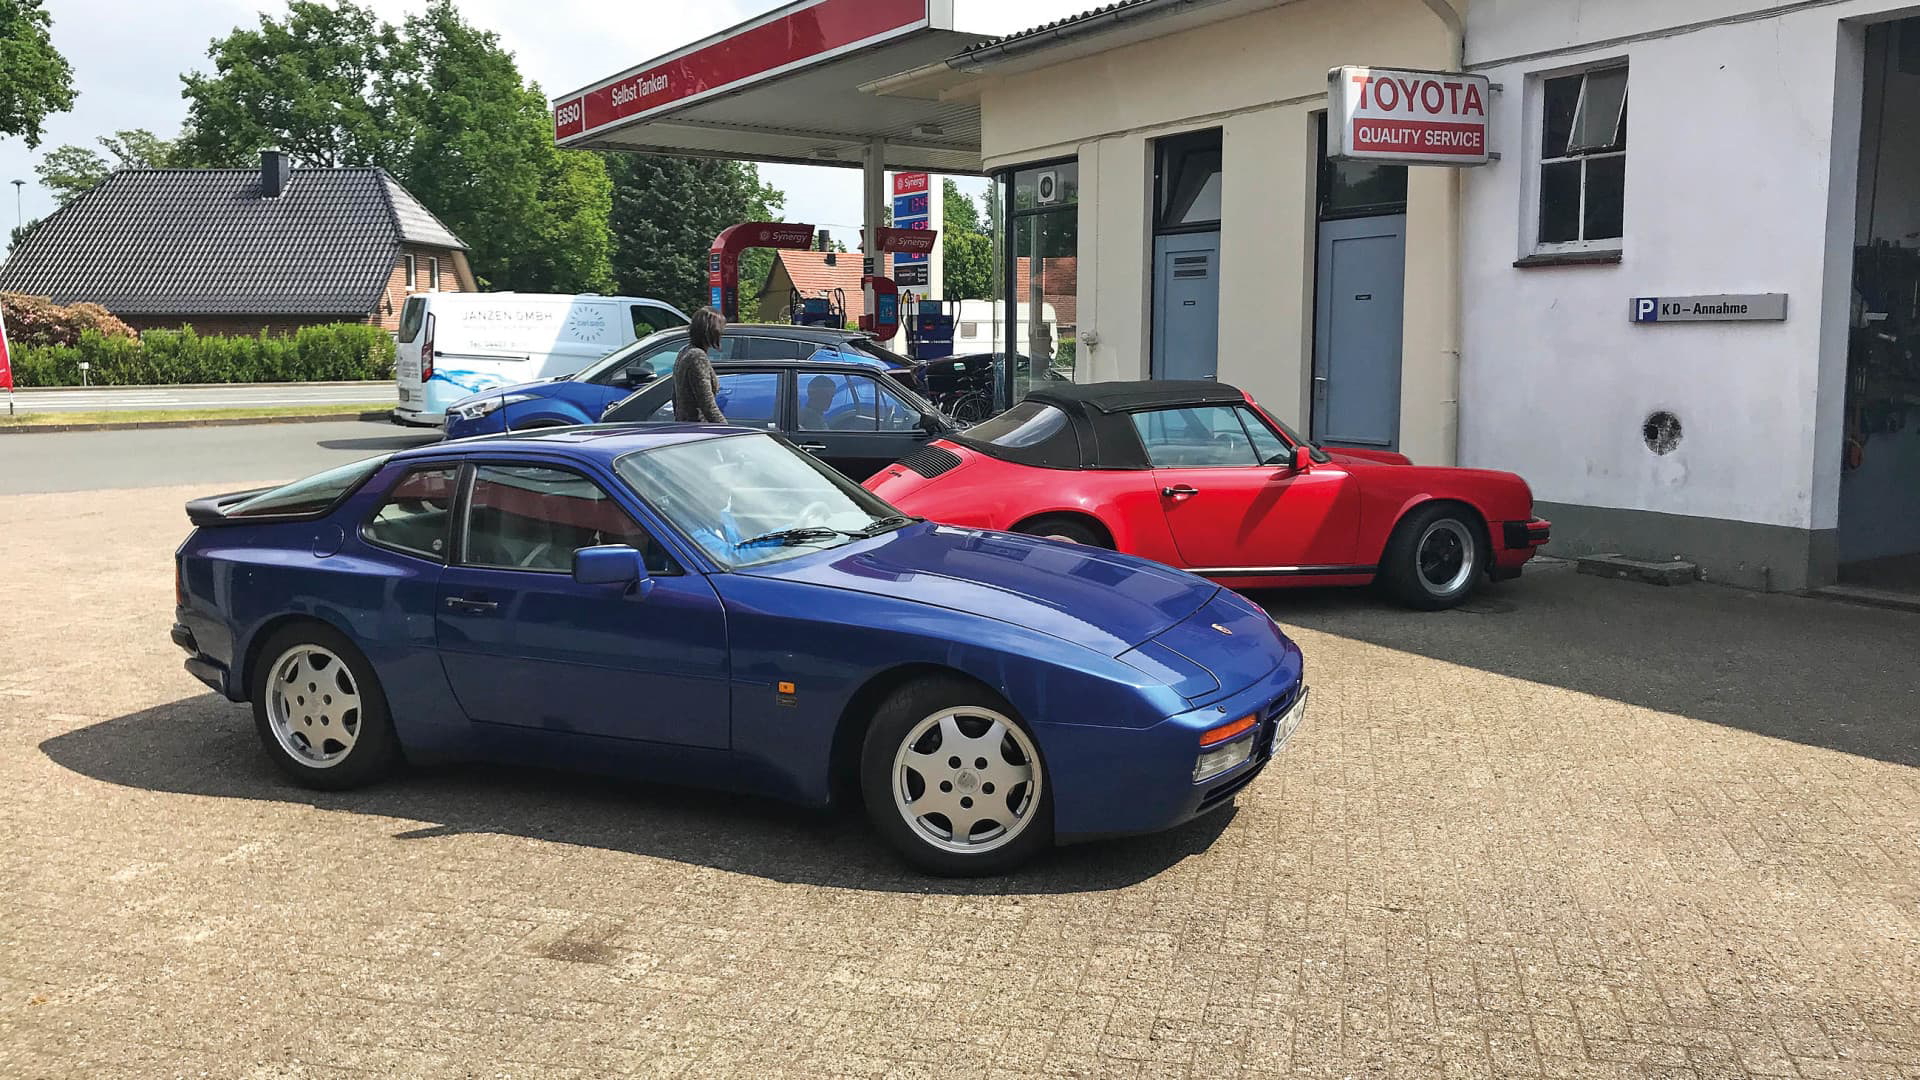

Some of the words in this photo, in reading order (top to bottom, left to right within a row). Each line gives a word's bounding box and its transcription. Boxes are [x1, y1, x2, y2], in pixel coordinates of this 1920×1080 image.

[612, 84, 637, 107] Selbst
[637, 73, 668, 97] Tanken
[1352, 76, 1484, 116] TOYOTA
[557, 103, 580, 126] ESSO
[1359, 127, 1421, 144] QUALITY
[1425, 130, 1480, 147] SERVICE
[904, 177, 925, 190] Synergy
[772, 231, 808, 243] Synergy
[897, 237, 930, 248] Synergy
[462, 310, 512, 320] JANZEN
[1638, 300, 1654, 320] P
